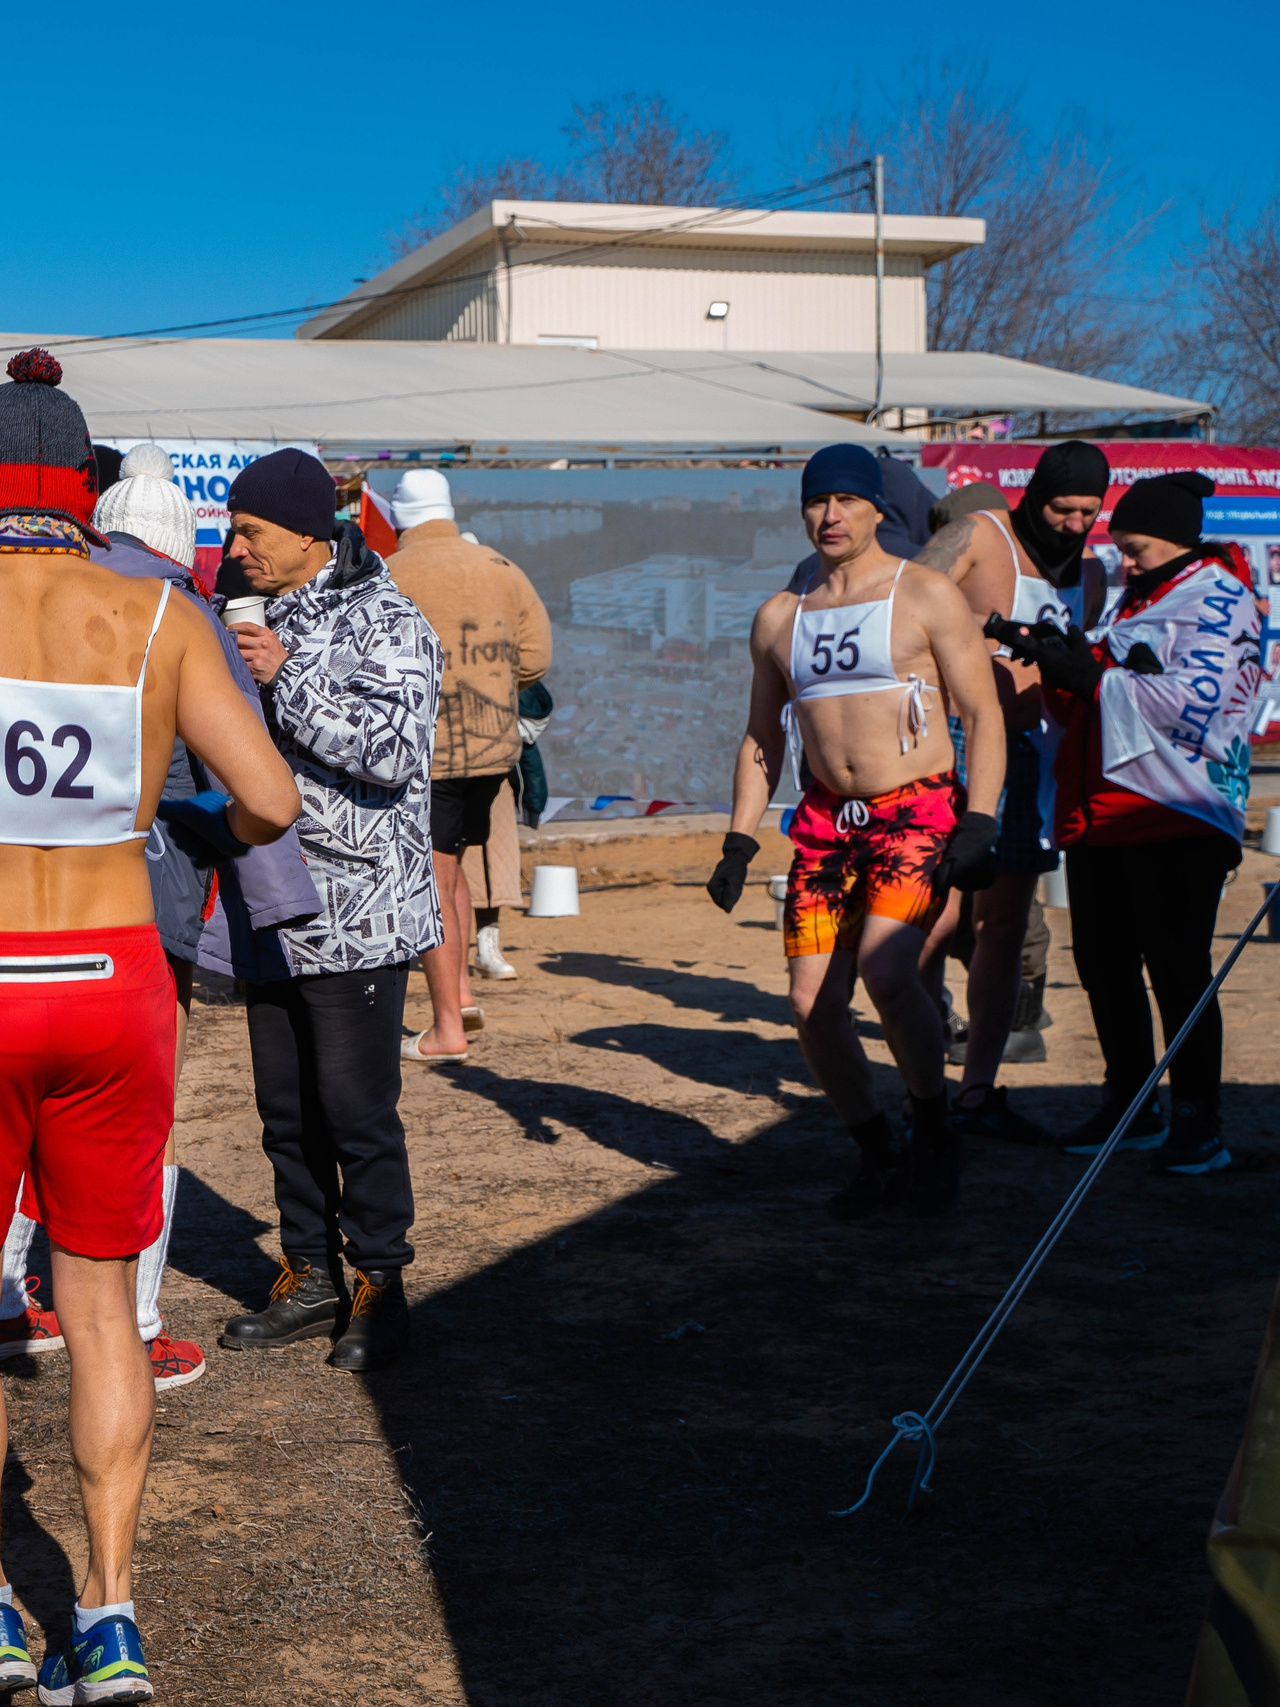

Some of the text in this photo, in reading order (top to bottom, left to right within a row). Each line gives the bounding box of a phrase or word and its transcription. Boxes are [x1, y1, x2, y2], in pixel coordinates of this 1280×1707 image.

[228, 453, 263, 469] АК
[172, 475, 231, 502] НО
[810, 627, 860, 676] 55
[4, 719, 94, 800] 62
